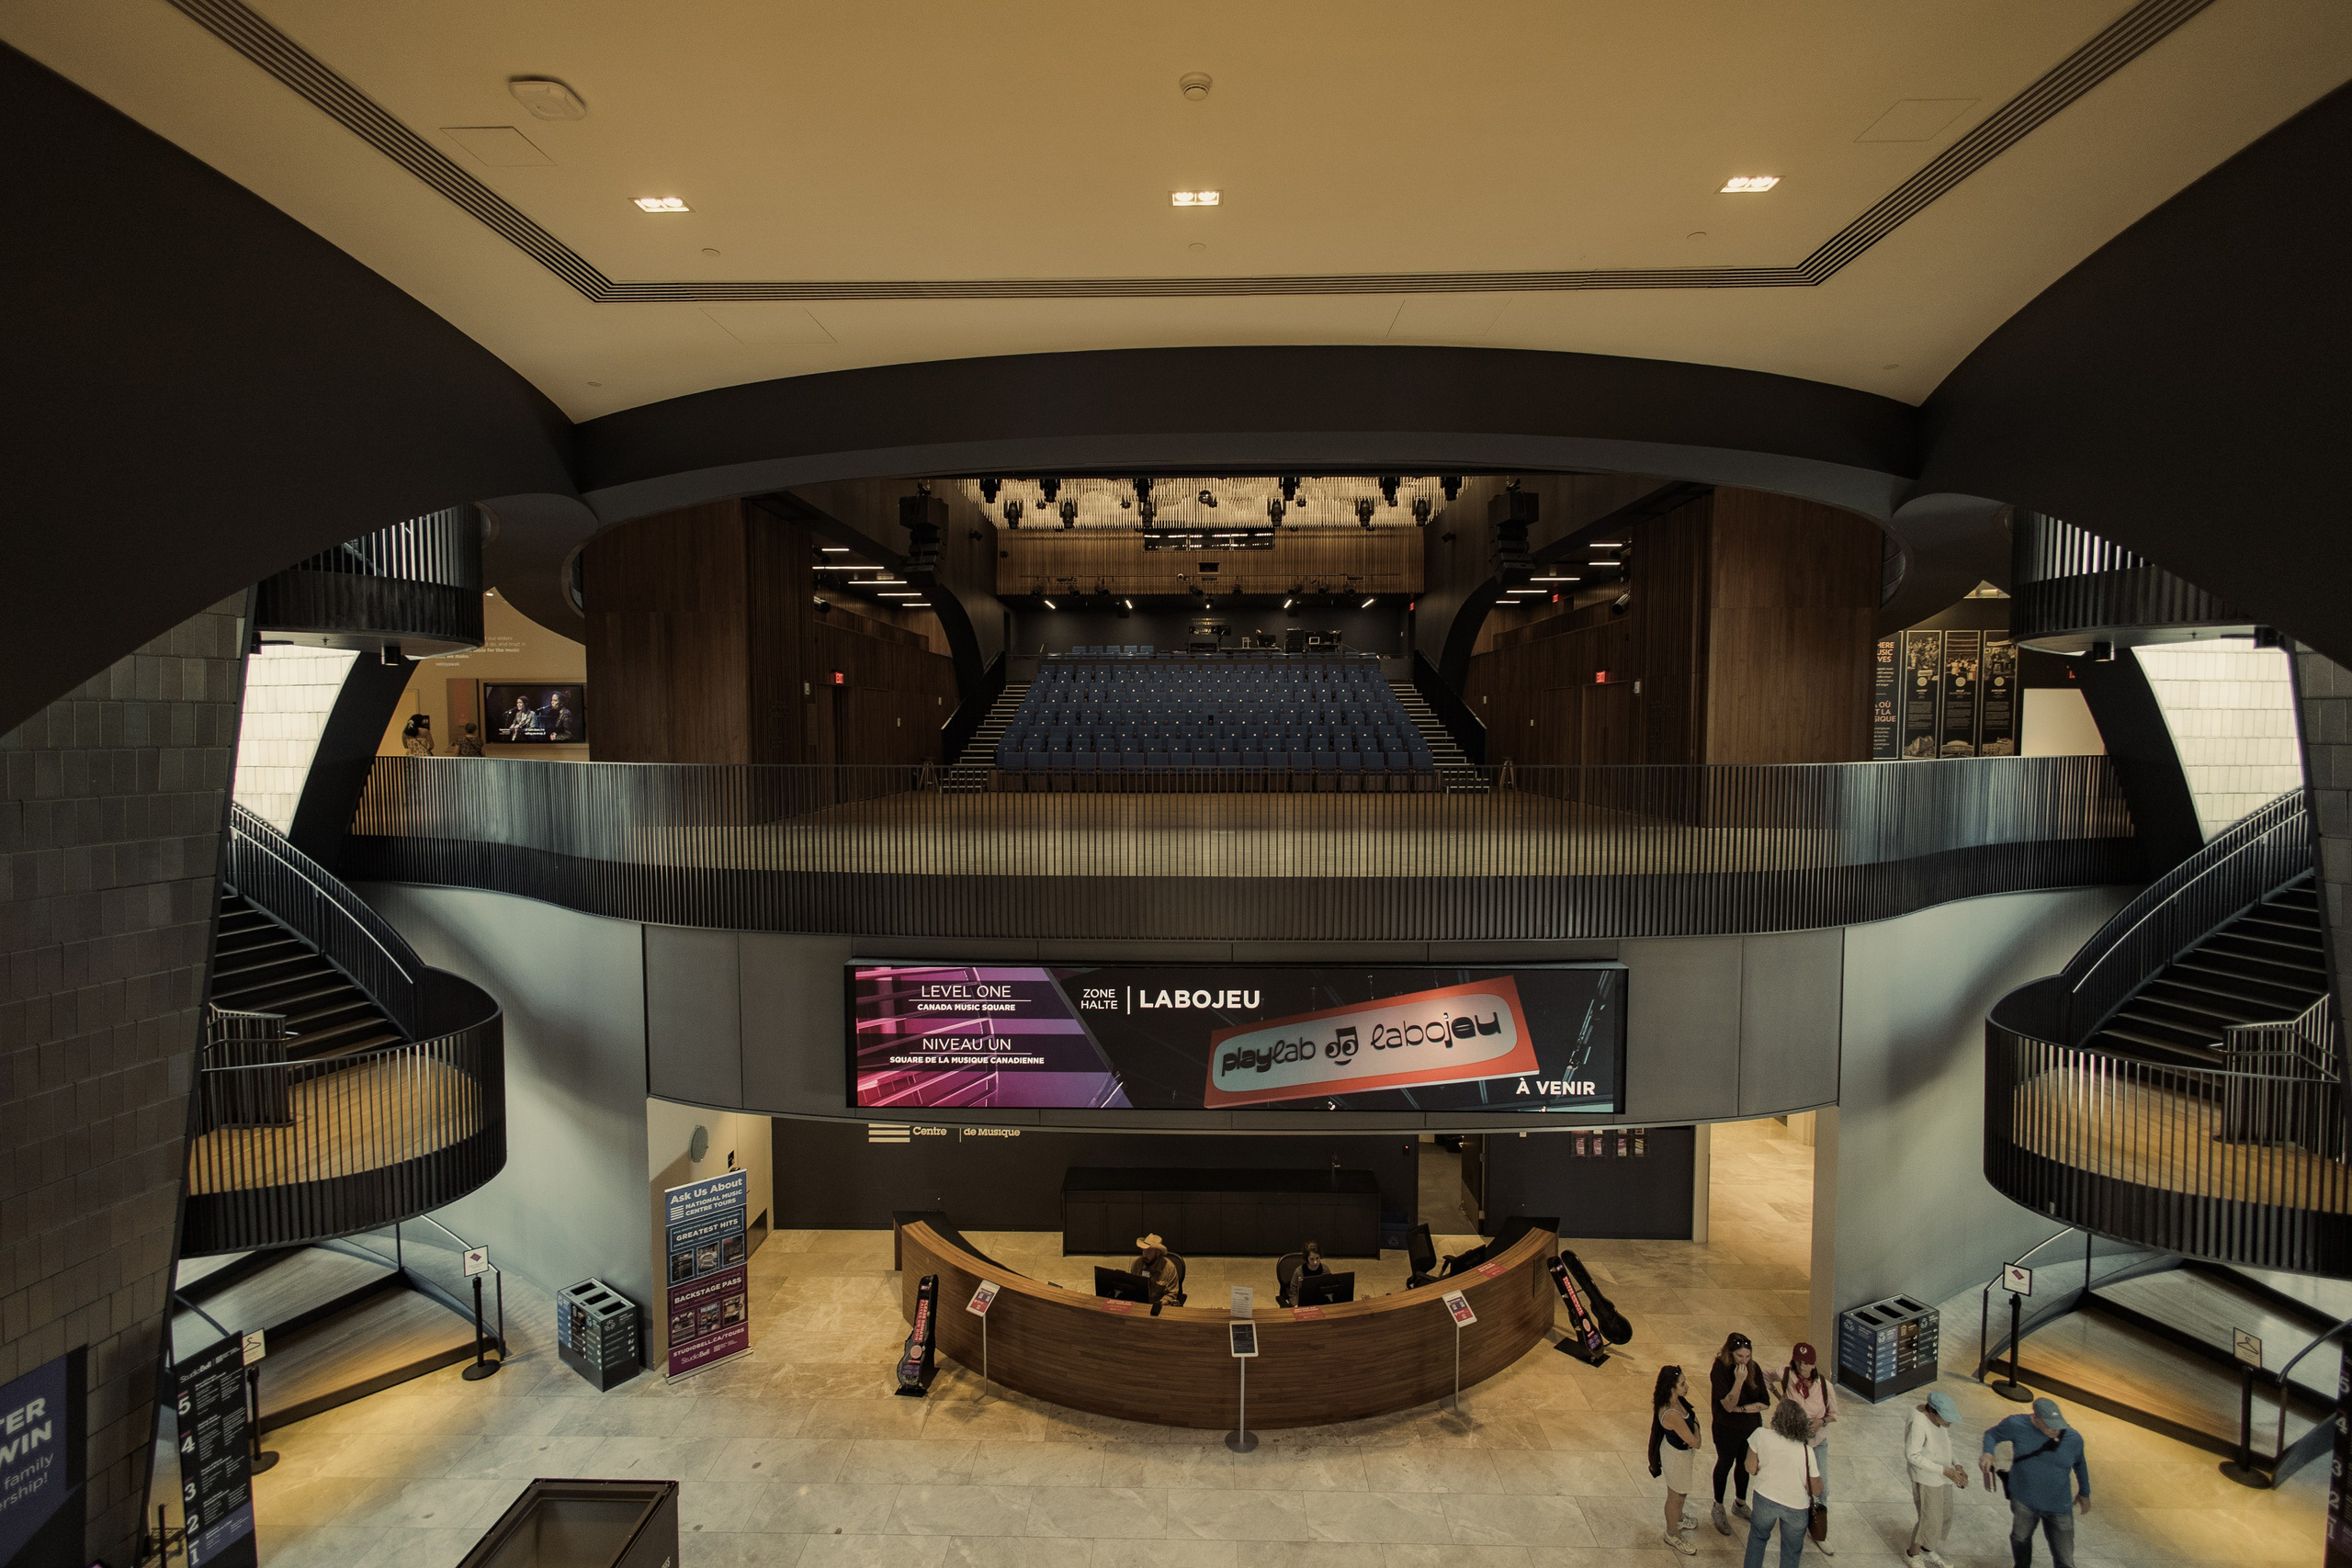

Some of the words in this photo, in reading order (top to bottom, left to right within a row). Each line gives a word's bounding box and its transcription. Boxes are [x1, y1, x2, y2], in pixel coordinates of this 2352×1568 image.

[922, 986, 973, 998] LEVEL
[977, 985, 1012, 998] ONE
[1083, 988, 1116, 998] ZONE
[1139, 989, 1261, 1010] LABOJEU
[917, 1003, 953, 1011] CANADA
[954, 1003, 980, 1011] MUSIC
[981, 1003, 1016, 1011] SQUARE
[1080, 999, 1118, 1010] HALTE
[922, 1038, 983, 1051] NIVEAU
[988, 1038, 1012, 1051] UN
[1221, 1036, 1317, 1077] playlab
[1370, 1011, 1501, 1051] labojeu
[951, 1056, 989, 1065] MUSIQUE
[989, 1056, 1045, 1065] CANADIENNE
[1516, 1077, 1531, 1095] À
[1536, 1081, 1596, 1096] VENIR
[912, 1126, 947, 1136] Centre
[963, 1128, 977, 1136] de
[978, 1128, 1021, 1138] Musique
[670, 1191, 691, 1204] Ask
[694, 1189, 707, 1198] Us
[710, 1178, 742, 1193] About
[685, 1196, 720, 1209] NATIONAL
[722, 1190, 742, 1199] MUSIC
[685, 1204, 712, 1216] CENTRE
[714, 1198, 736, 1208] TOURS
[676, 1224, 718, 1242] GREATEST
[720, 1218, 738, 1228] HITS
[674, 1283, 720, 1303] BACKSTAGE
[721, 1277, 741, 1288] PASS
[673, 1327, 744, 1357] STUDIOBELL.CA/TOURS
[681, 1348, 710, 1364] StudioBell
[2339, 1375, 2349, 1393] 5
[178, 1395, 191, 1416] 5
[2335, 1416, 2347, 1435] 4
[181, 1435, 195, 1454] 4
[5, 1453, 53, 1490] family
[2332, 1459, 2342, 1478] 3
[185, 1482, 197, 1502] 3
[2329, 1491, 2340, 1509] 2
[187, 1515, 199, 1535] 2
[188, 1548, 199, 1566] 1
